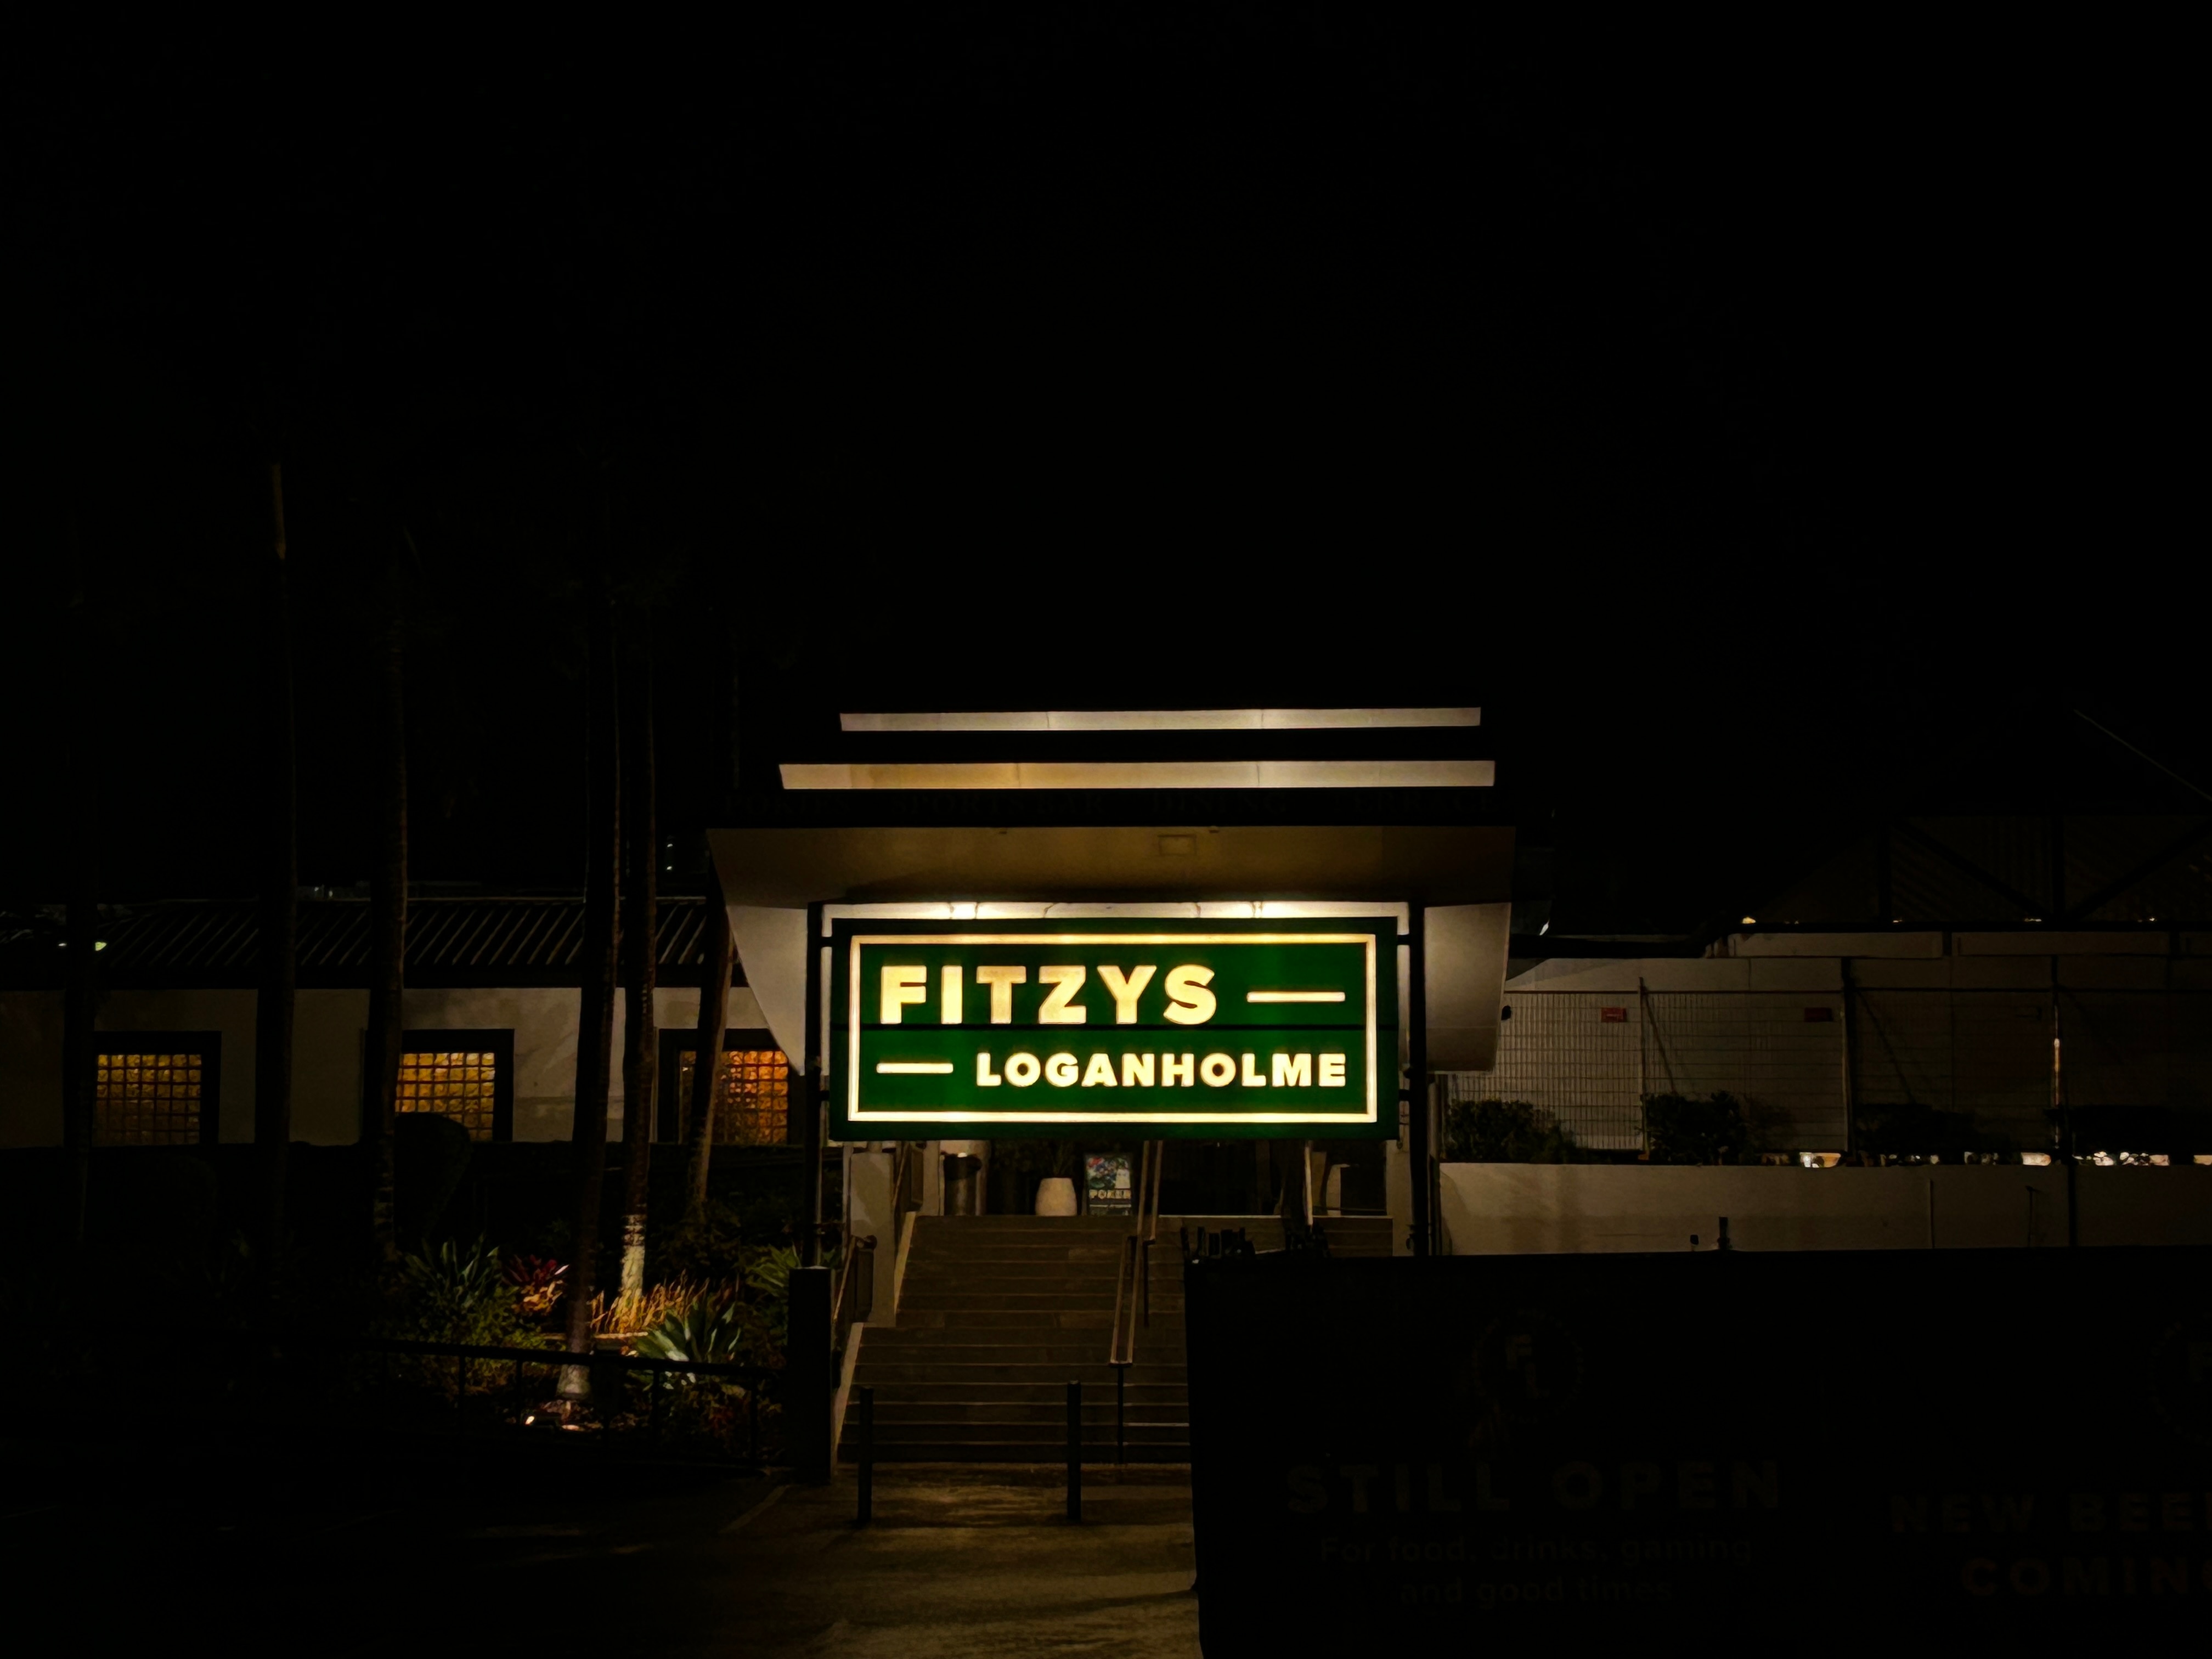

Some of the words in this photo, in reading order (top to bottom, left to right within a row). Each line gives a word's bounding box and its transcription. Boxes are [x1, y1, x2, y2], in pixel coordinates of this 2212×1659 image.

[880, 964, 1216, 1025] FITZYS
[976, 1052, 1346, 1088] LOGANHOLME
[1285, 1462, 1511, 1513] STILL
[1551, 1460, 1779, 1511] OPEN
[1890, 1493, 2035, 1533] NEW
[2069, 1492, 2212, 1533] BEE
[1319, 1537, 1376, 1563] For
[1387, 1537, 1477, 1563] food,
[1489, 1535, 1609, 1562] drinks,
[1620, 1534, 1752, 1567] gaming
[1400, 1577, 1463, 1605] and
[1476, 1576, 1564, 1610] good
[1578, 1575, 1673, 1603] times
